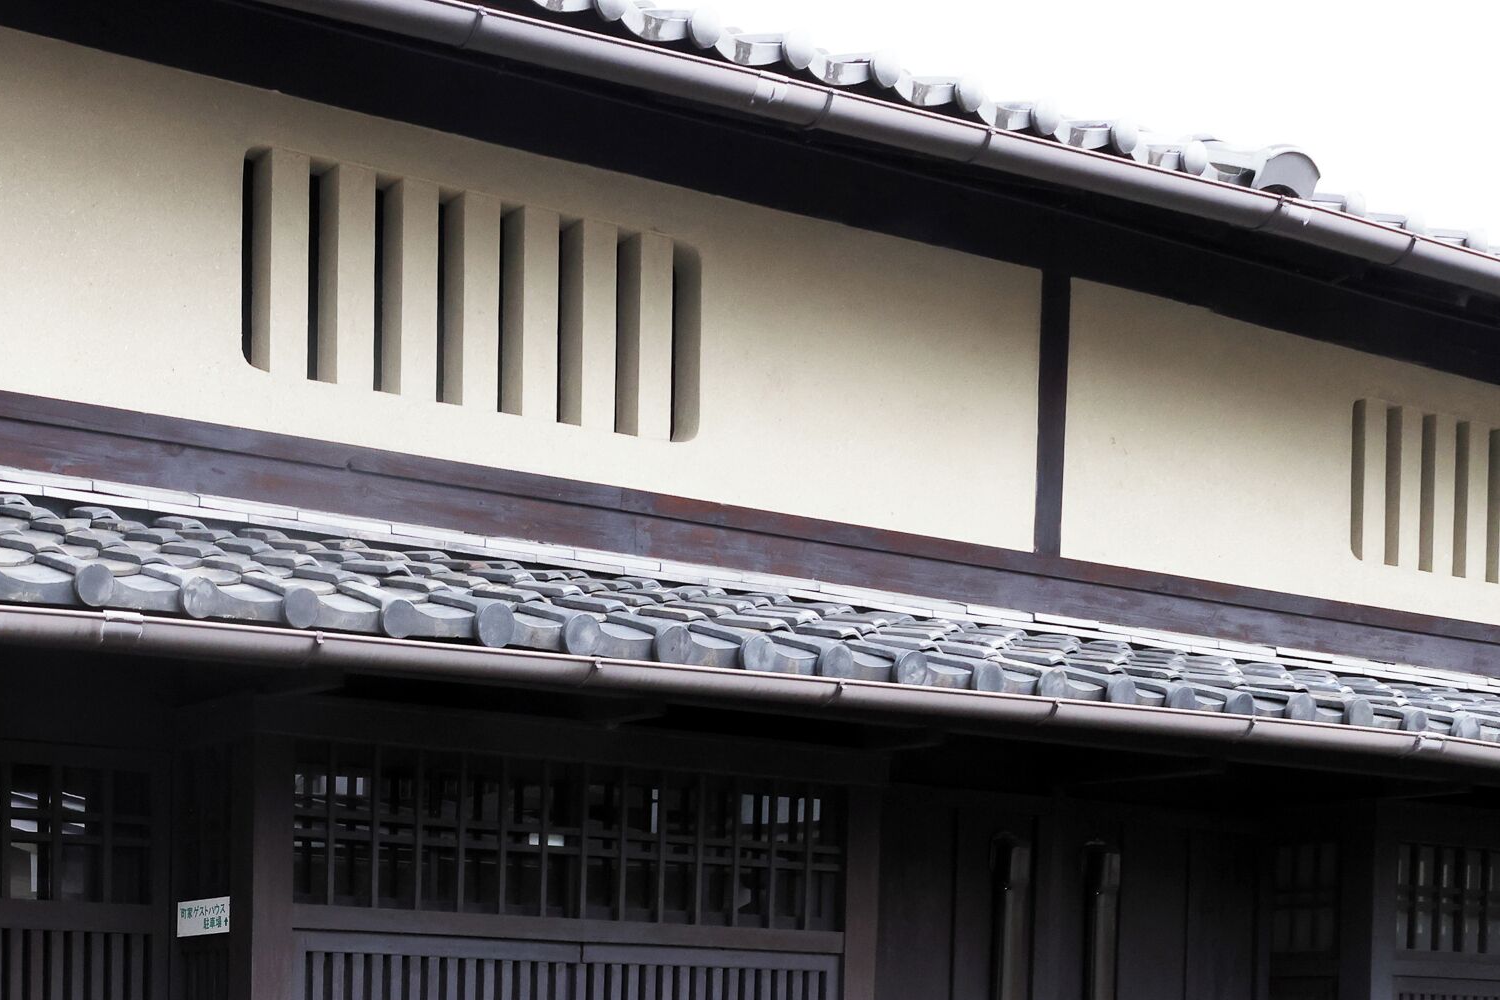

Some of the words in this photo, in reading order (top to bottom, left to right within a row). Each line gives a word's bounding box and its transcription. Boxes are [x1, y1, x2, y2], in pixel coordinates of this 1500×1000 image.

[180, 903, 226, 920] 町家ゲストハウス
[203, 915, 222, 930] 駐車場
